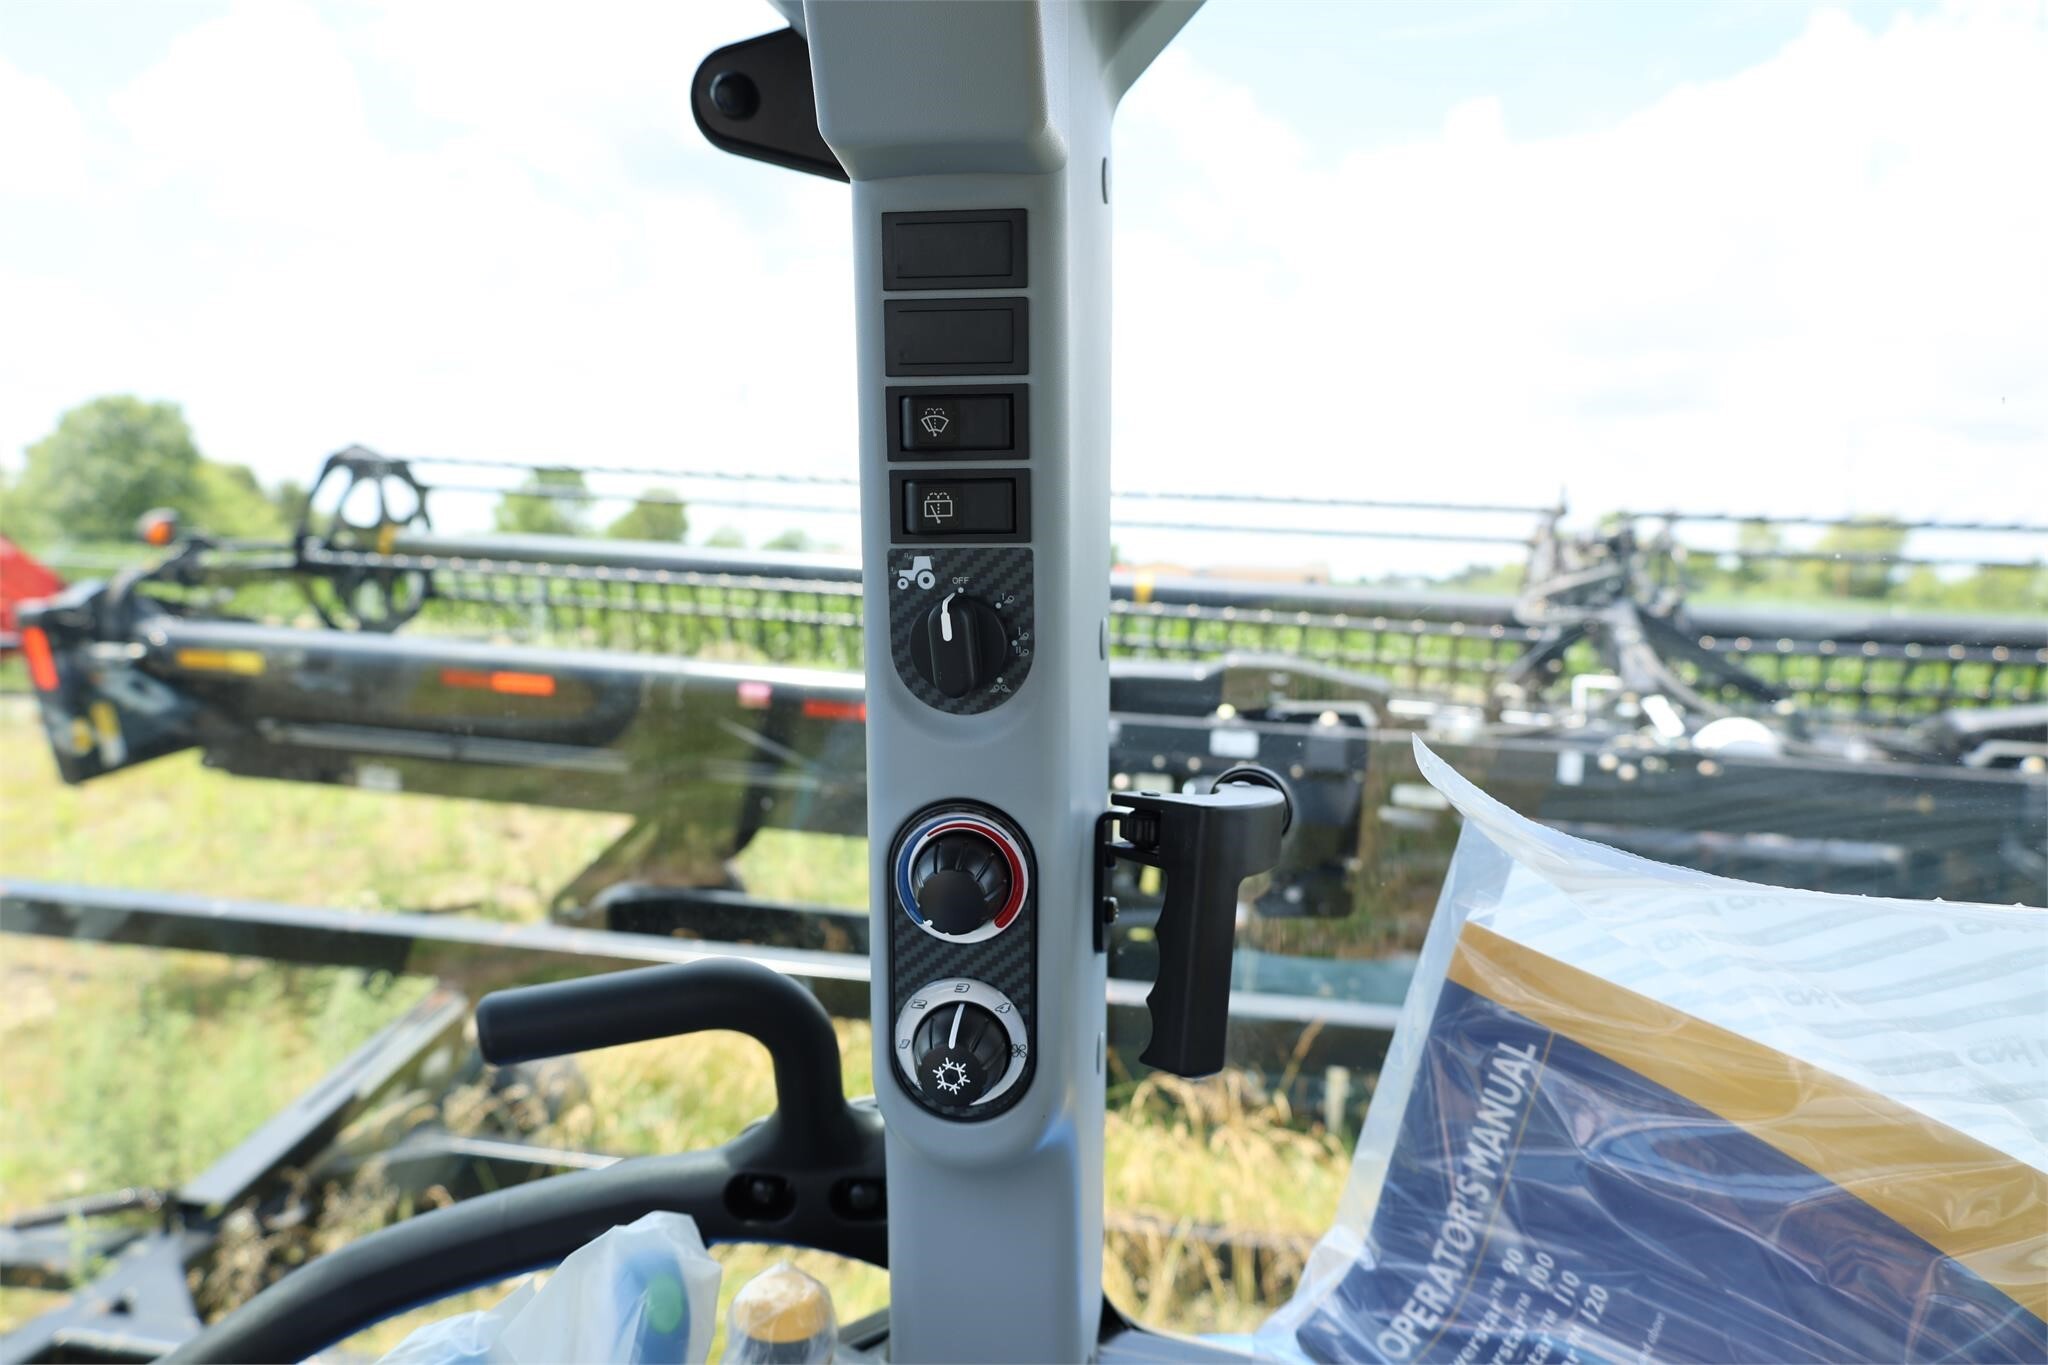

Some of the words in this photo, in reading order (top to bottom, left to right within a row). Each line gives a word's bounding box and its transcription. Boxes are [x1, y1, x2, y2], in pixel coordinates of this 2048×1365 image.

[952, 576, 970, 585] OFF
[954, 983, 970, 993] 3
[911, 999, 928, 1009] 2
[995, 1002, 1011, 1013] 4
[899, 1039, 910, 1049] 1
[1376, 1174, 1491, 1360] OPERATOR'S
[1463, 1040, 1537, 1179] MANUAL
[1501, 1247, 1524, 1276] 90
[1527, 1251, 1555, 1292] 100
[1553, 1269, 1581, 1308] 110
[1580, 1283, 1609, 1324] 120
[1647, 1311, 1667, 1346] above
